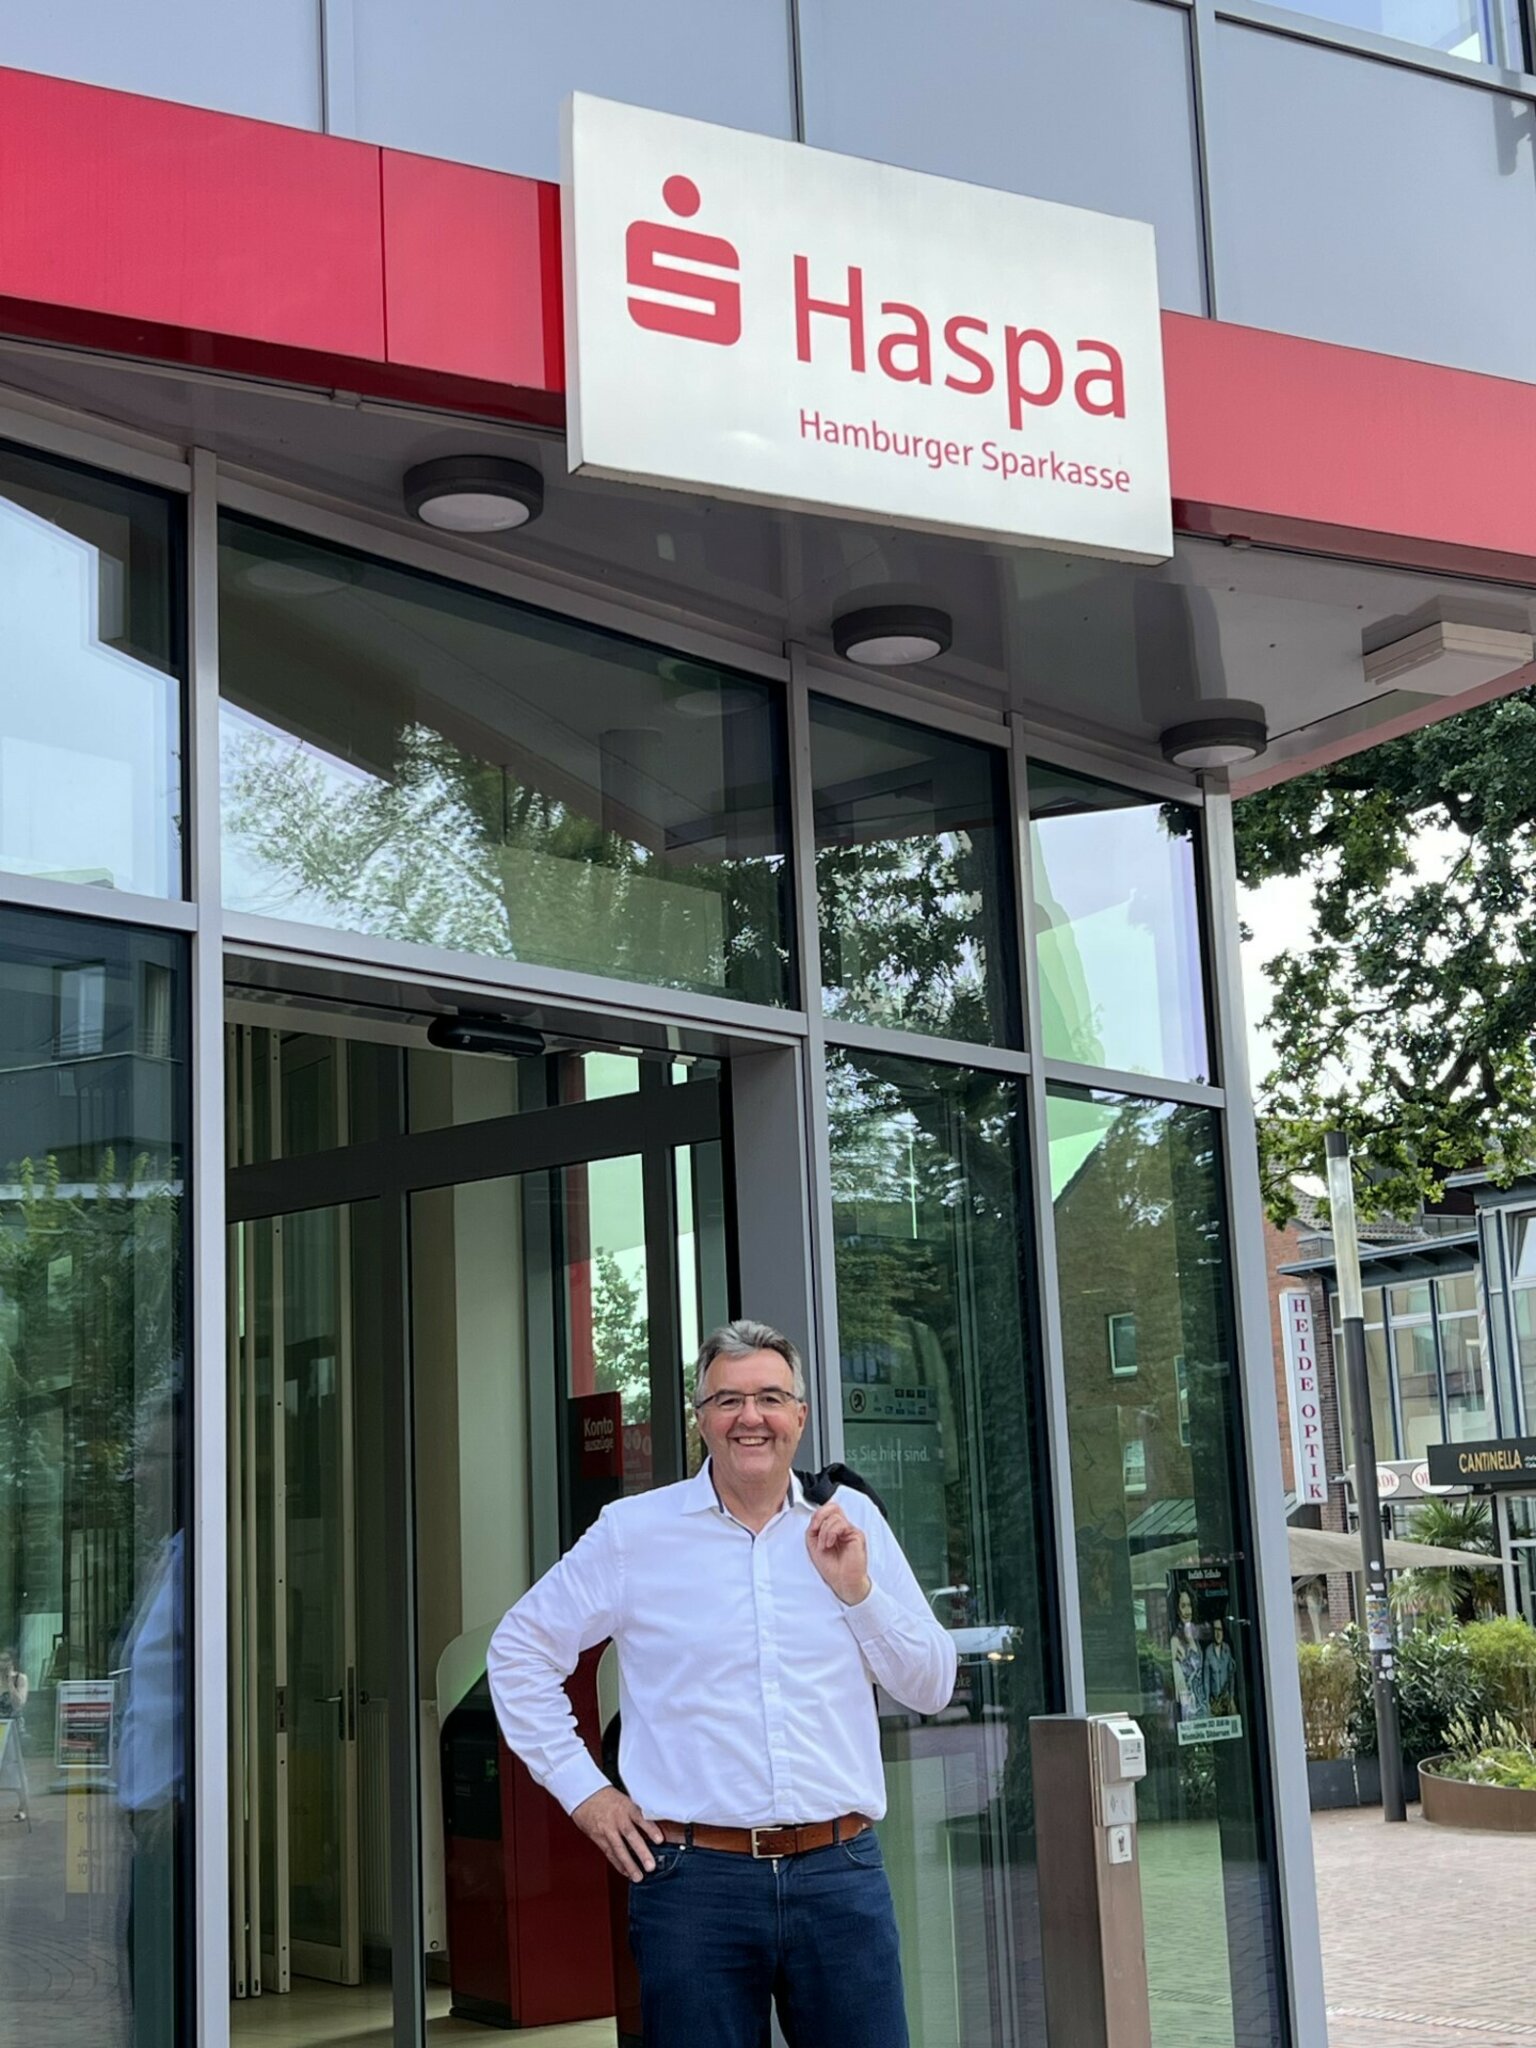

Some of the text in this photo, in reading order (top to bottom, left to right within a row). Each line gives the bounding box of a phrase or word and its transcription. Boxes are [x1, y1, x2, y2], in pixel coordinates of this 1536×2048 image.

[793, 254, 1127, 431] Haspa
[800, 408, 1131, 493] Hamburger Sparkasse
[1293, 1299, 1323, 1498] HEIDE OPTIK
[584, 1417, 614, 1437] Konto
[860, 1445, 878, 1461] Sie
[880, 1445, 902, 1461] hier
[1459, 1449, 1523, 1473] CANTINELLA
